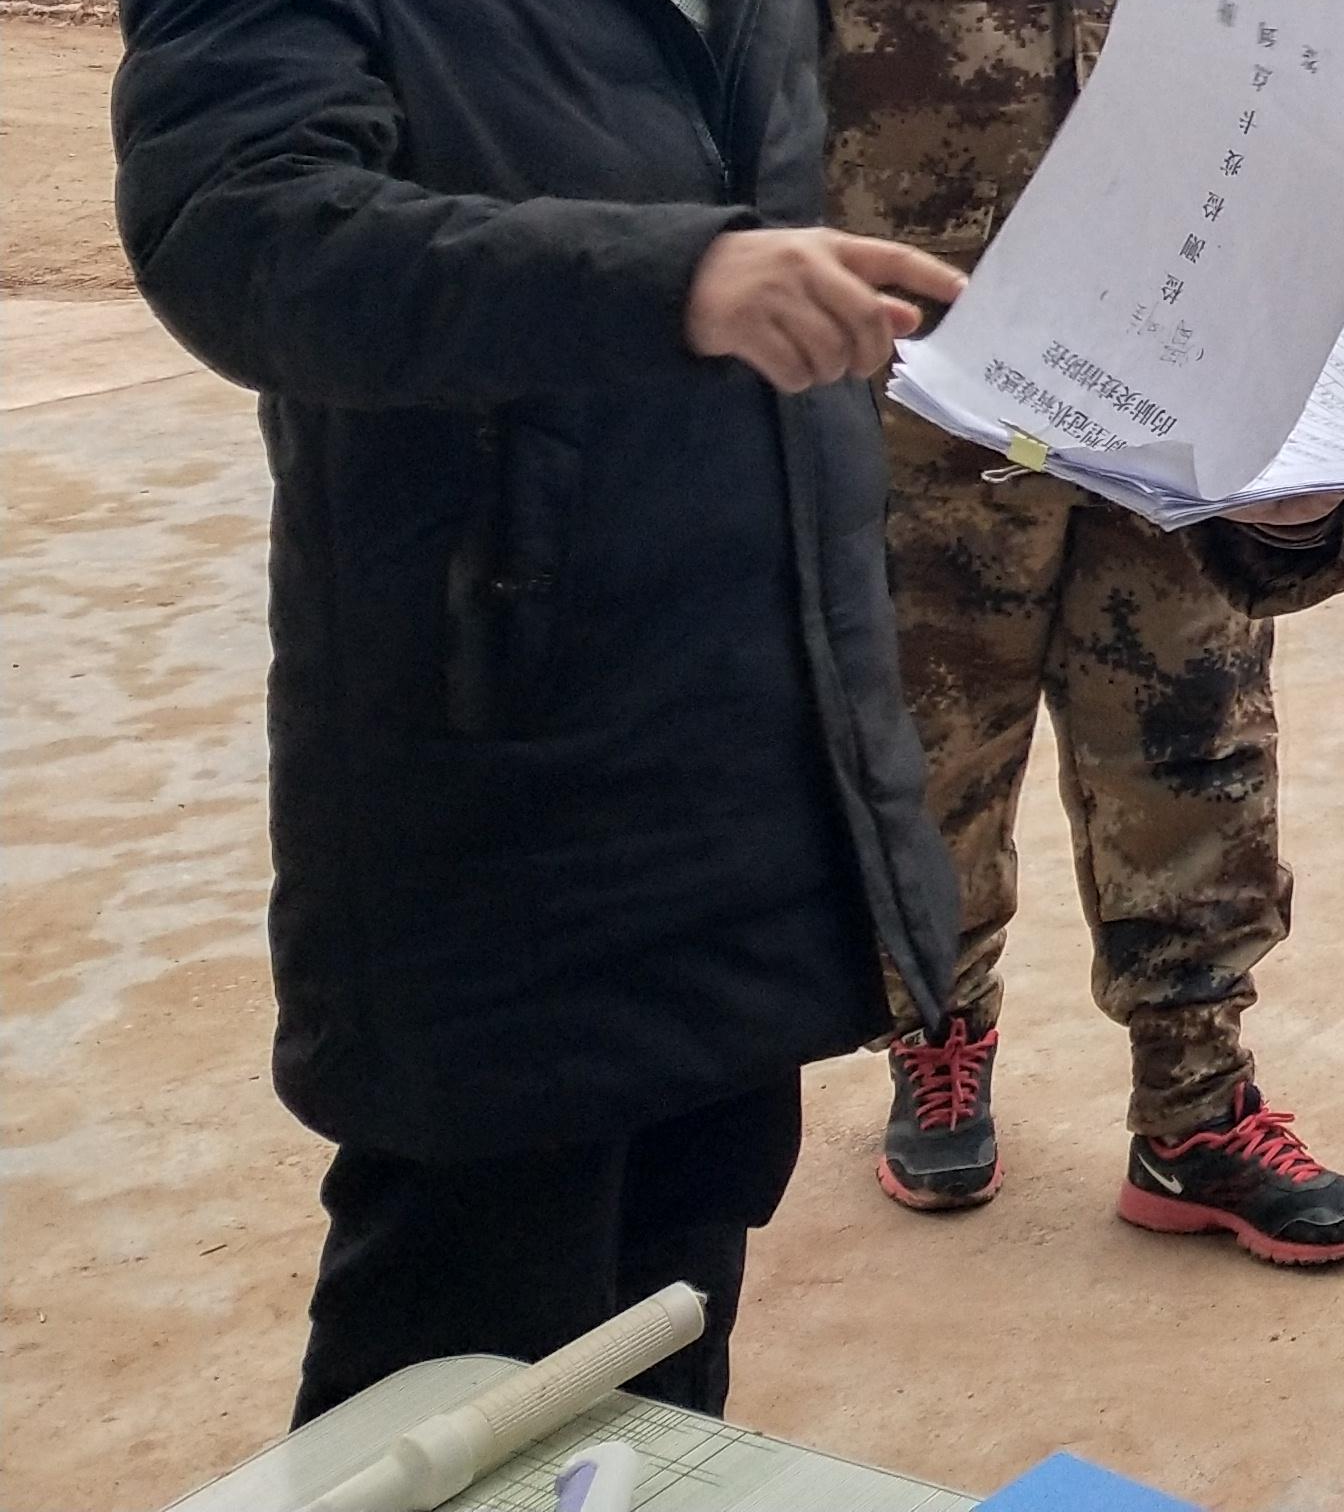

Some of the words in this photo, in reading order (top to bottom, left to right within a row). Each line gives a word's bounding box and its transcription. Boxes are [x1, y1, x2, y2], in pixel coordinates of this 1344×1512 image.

[1041, 339, 1178, 438] 的肺炎疫情防控
